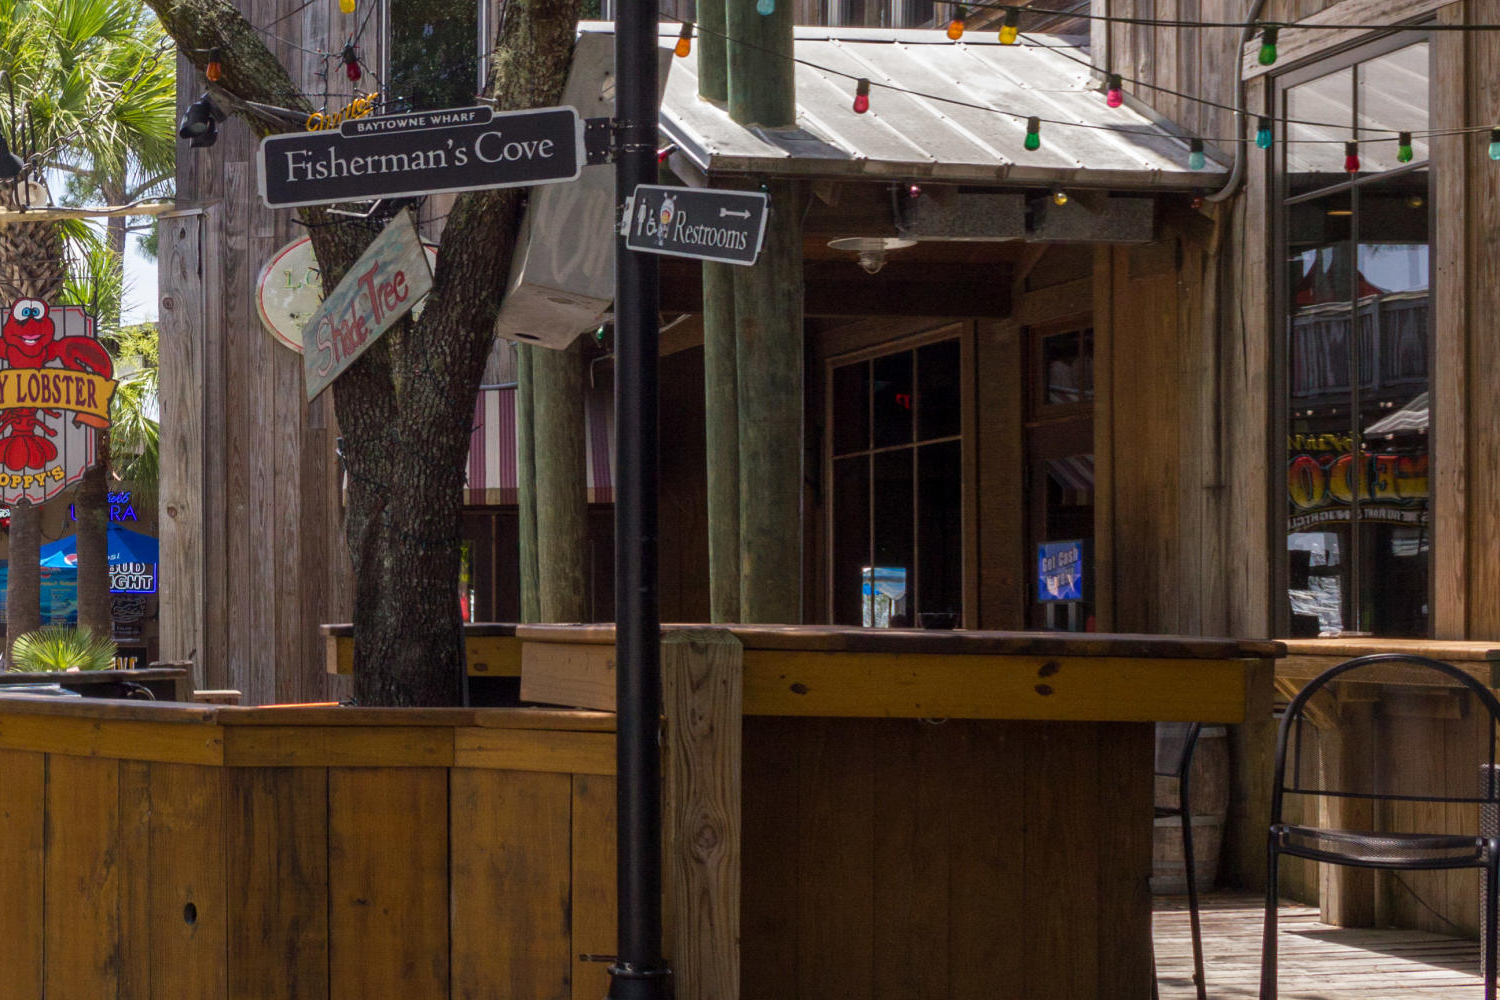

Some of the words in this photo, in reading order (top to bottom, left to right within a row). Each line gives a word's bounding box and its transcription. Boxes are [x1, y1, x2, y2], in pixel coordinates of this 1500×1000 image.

[357, 115, 427, 133] BAYTOWNE
[430, 110, 476, 126] WHARF
[283, 138, 468, 183] Fisherman's
[474, 131, 554, 163] Cove
[673, 210, 748, 251] Restrooms
[316, 300, 369, 377] Shade
[358, 260, 409, 325] Tree
[16, 373, 99, 409] LOBSTER
[110, 575, 153, 589] IGHT
